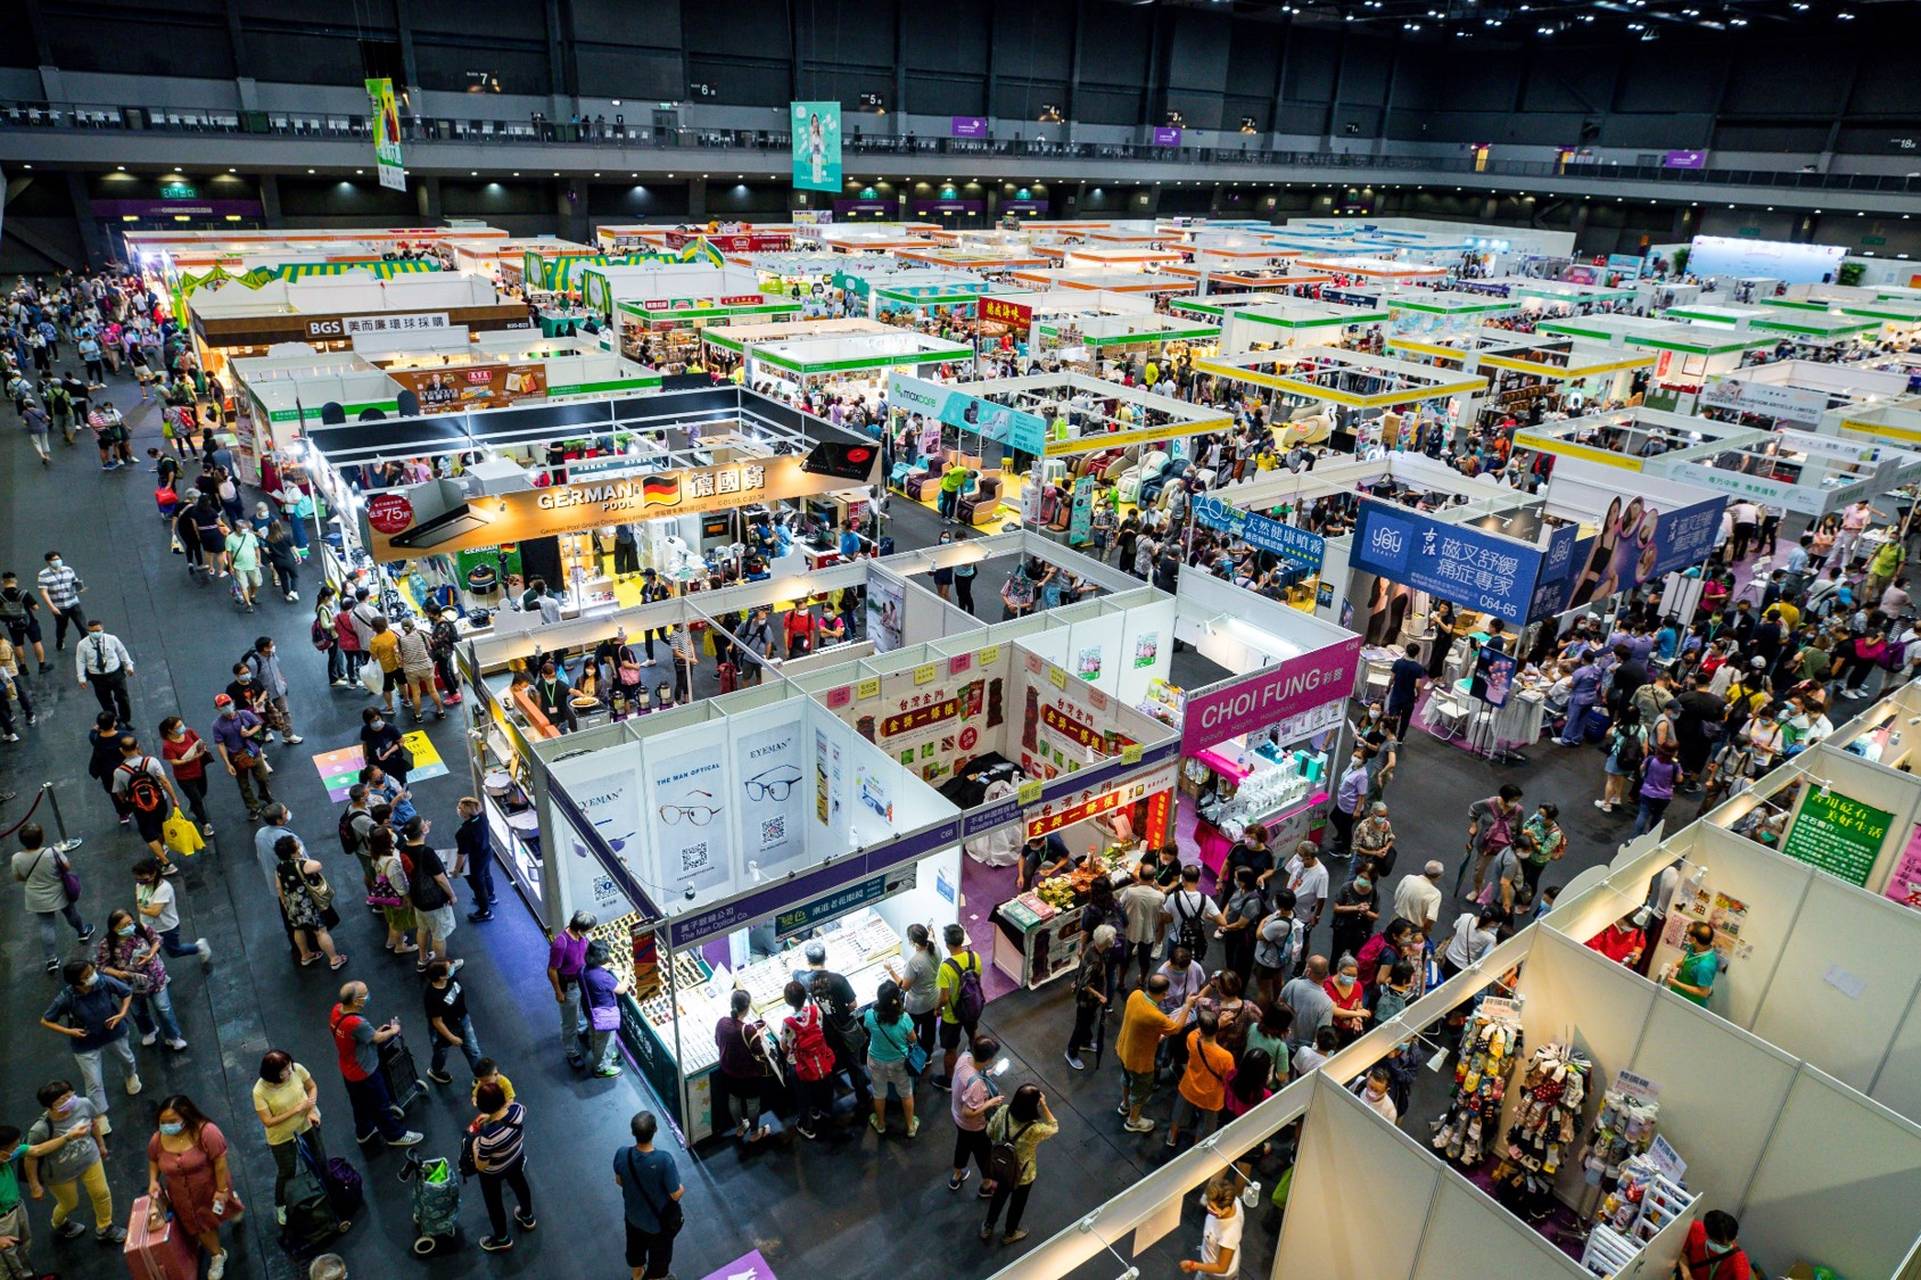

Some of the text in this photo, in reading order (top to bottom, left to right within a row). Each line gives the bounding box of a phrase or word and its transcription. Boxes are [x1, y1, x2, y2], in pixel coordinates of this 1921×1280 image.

[480, 73, 488, 84] 7
[701, 84, 708, 95] 6
[870, 94, 876, 104] 5
[1901, 139, 1912, 148] 18
[310, 321, 341, 335] BGS
[903, 389, 936, 408] maxcare
[538, 482, 632, 510] GERMAN
[602, 501, 635, 512] POOL
[1247, 518, 1322, 555] 天然健康噴霧
[1440, 537, 1519, 580] 磁叉舒緩
[1436, 559, 1516, 598] 痛症專家
[1479, 595, 1517, 618] C64-65
[900, 690, 944, 711] 台灣金門
[1201, 668, 1321, 728] CHOI FUNG
[750, 742, 788, 759] EYEMAN
[657, 764, 720, 786] THE MAN OPTICAL
[1825, 809, 1883, 839] 美好生活
[681, 932, 695, 942] The
[696, 926, 712, 937] Man
[713, 916, 736, 930] Optical
